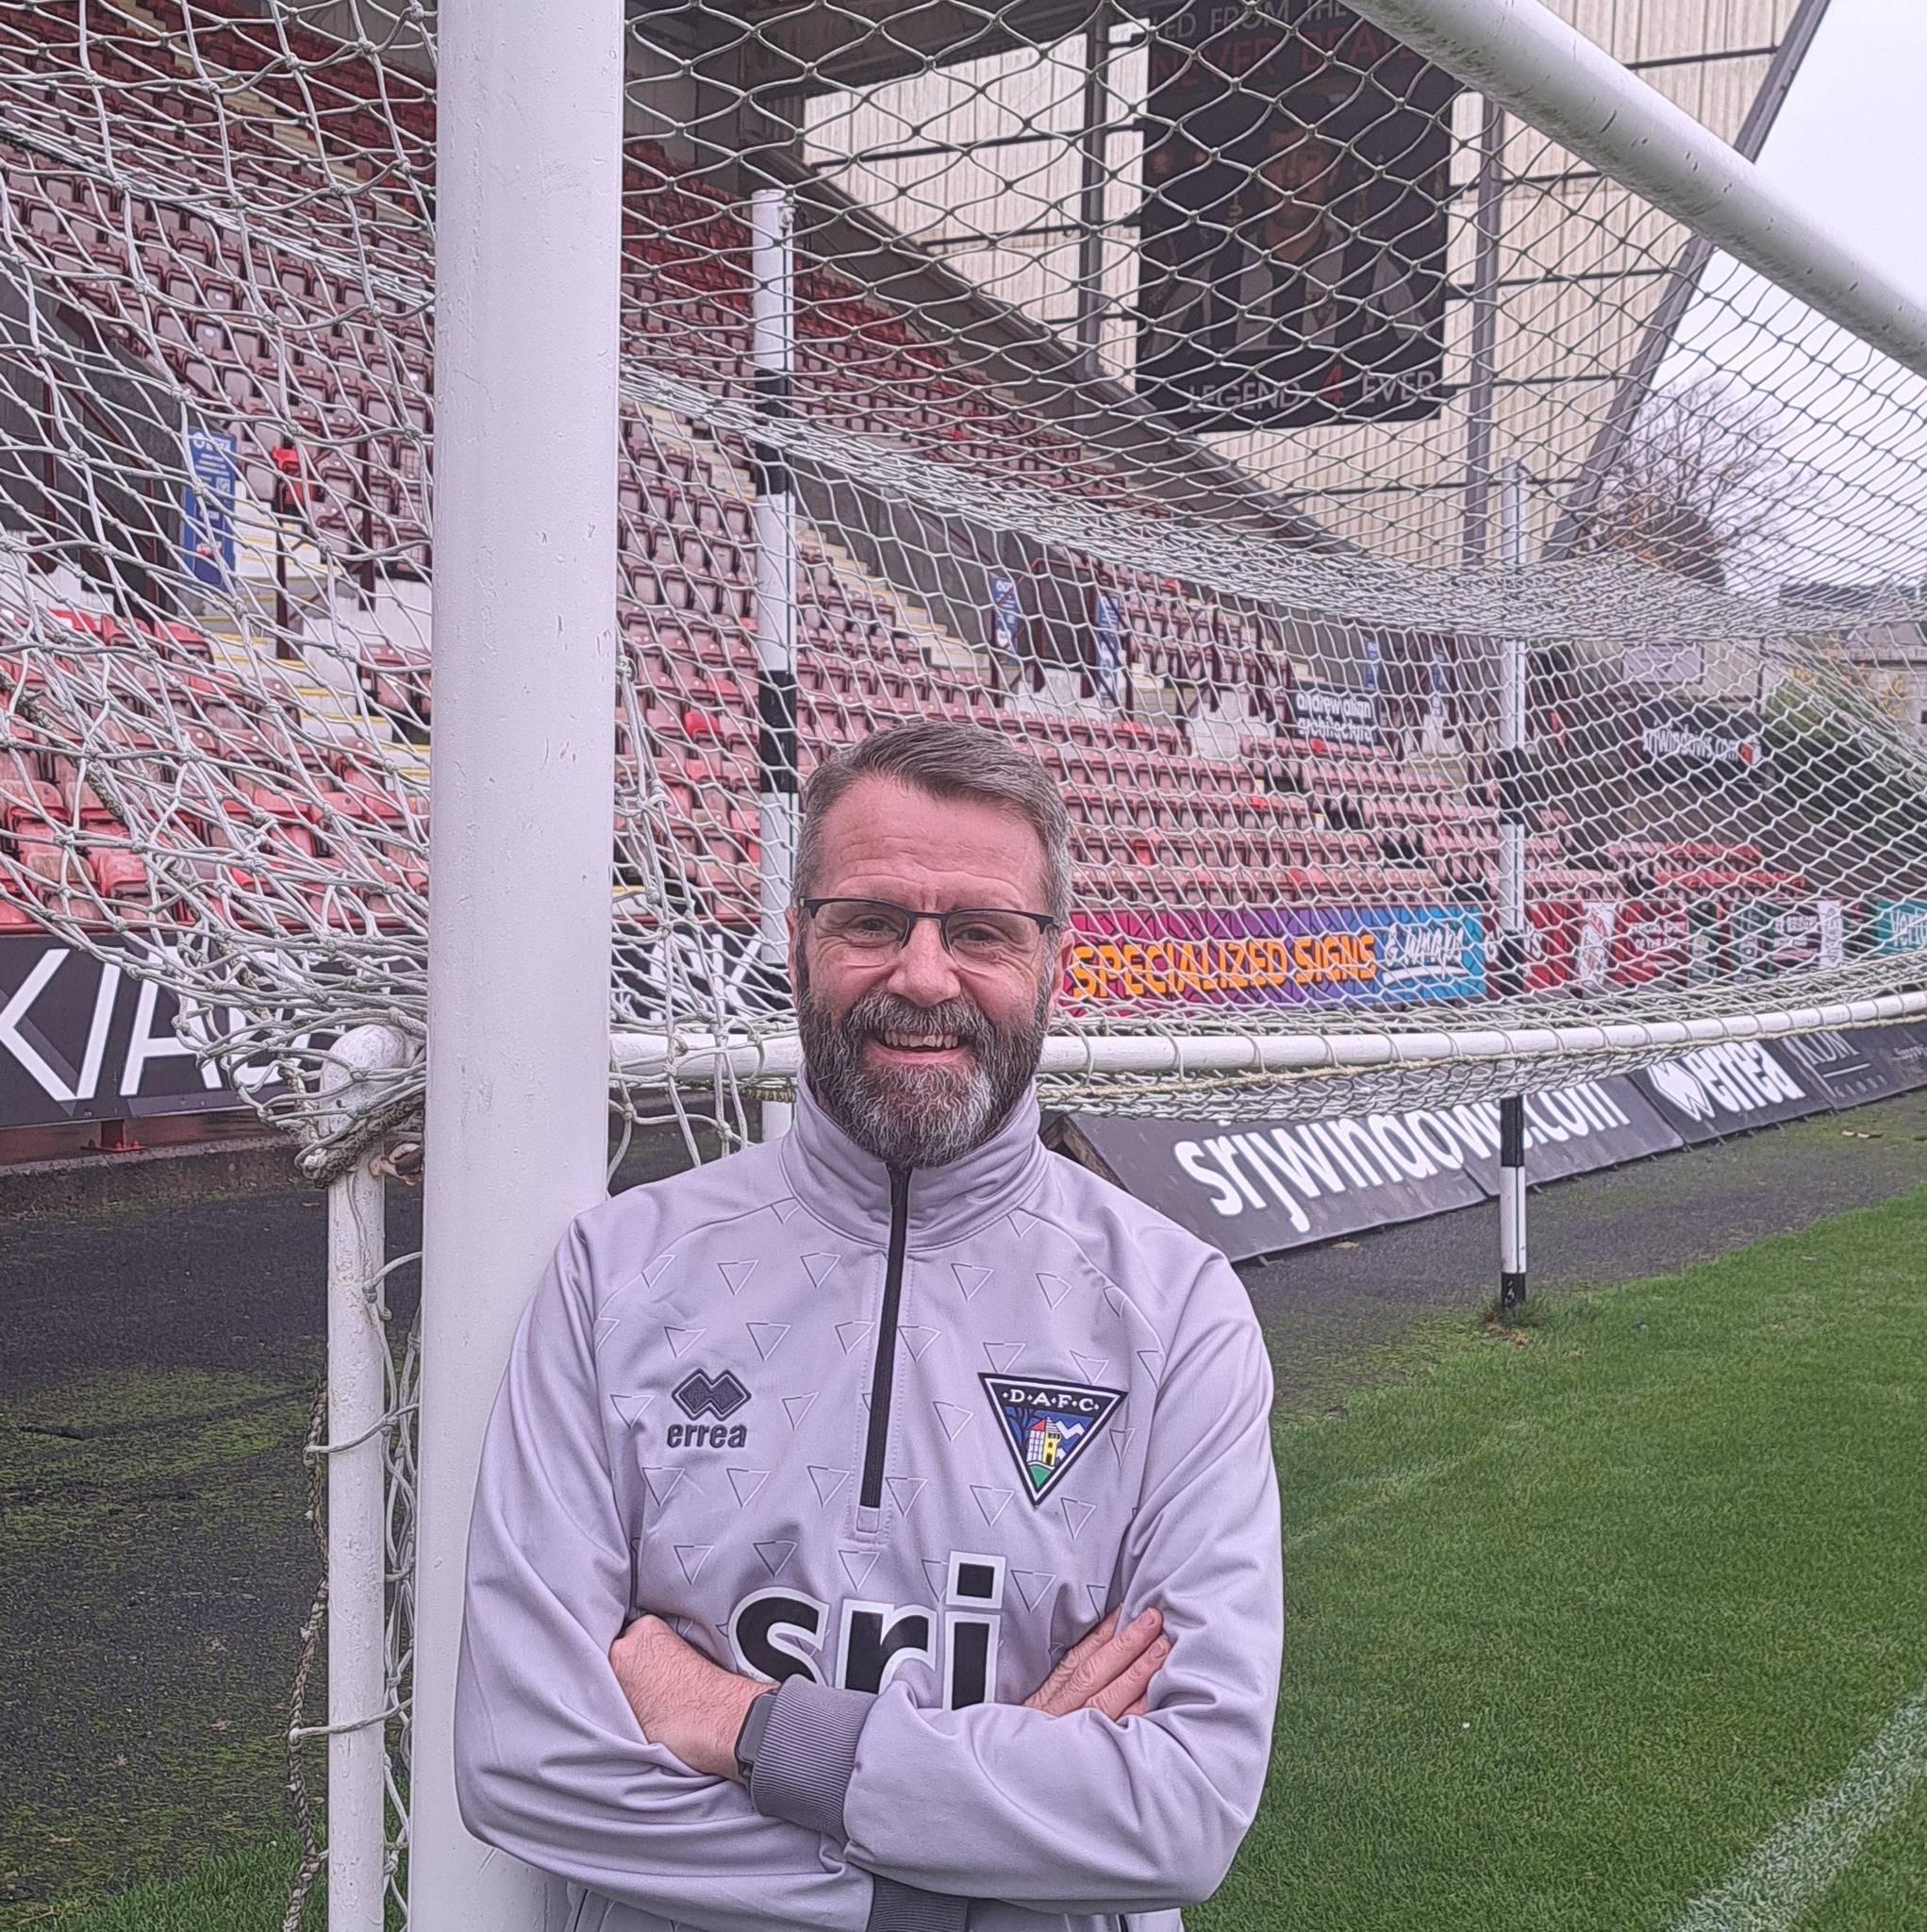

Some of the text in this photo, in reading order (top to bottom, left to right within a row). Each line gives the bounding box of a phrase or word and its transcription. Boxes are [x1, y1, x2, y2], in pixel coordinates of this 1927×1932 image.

[1189, 364, 1436, 414] LEGEND 4 EVER
[1073, 935, 1377, 1000] SPECIALIZED SIGNS
[667, 1424, 747, 1449] errea
